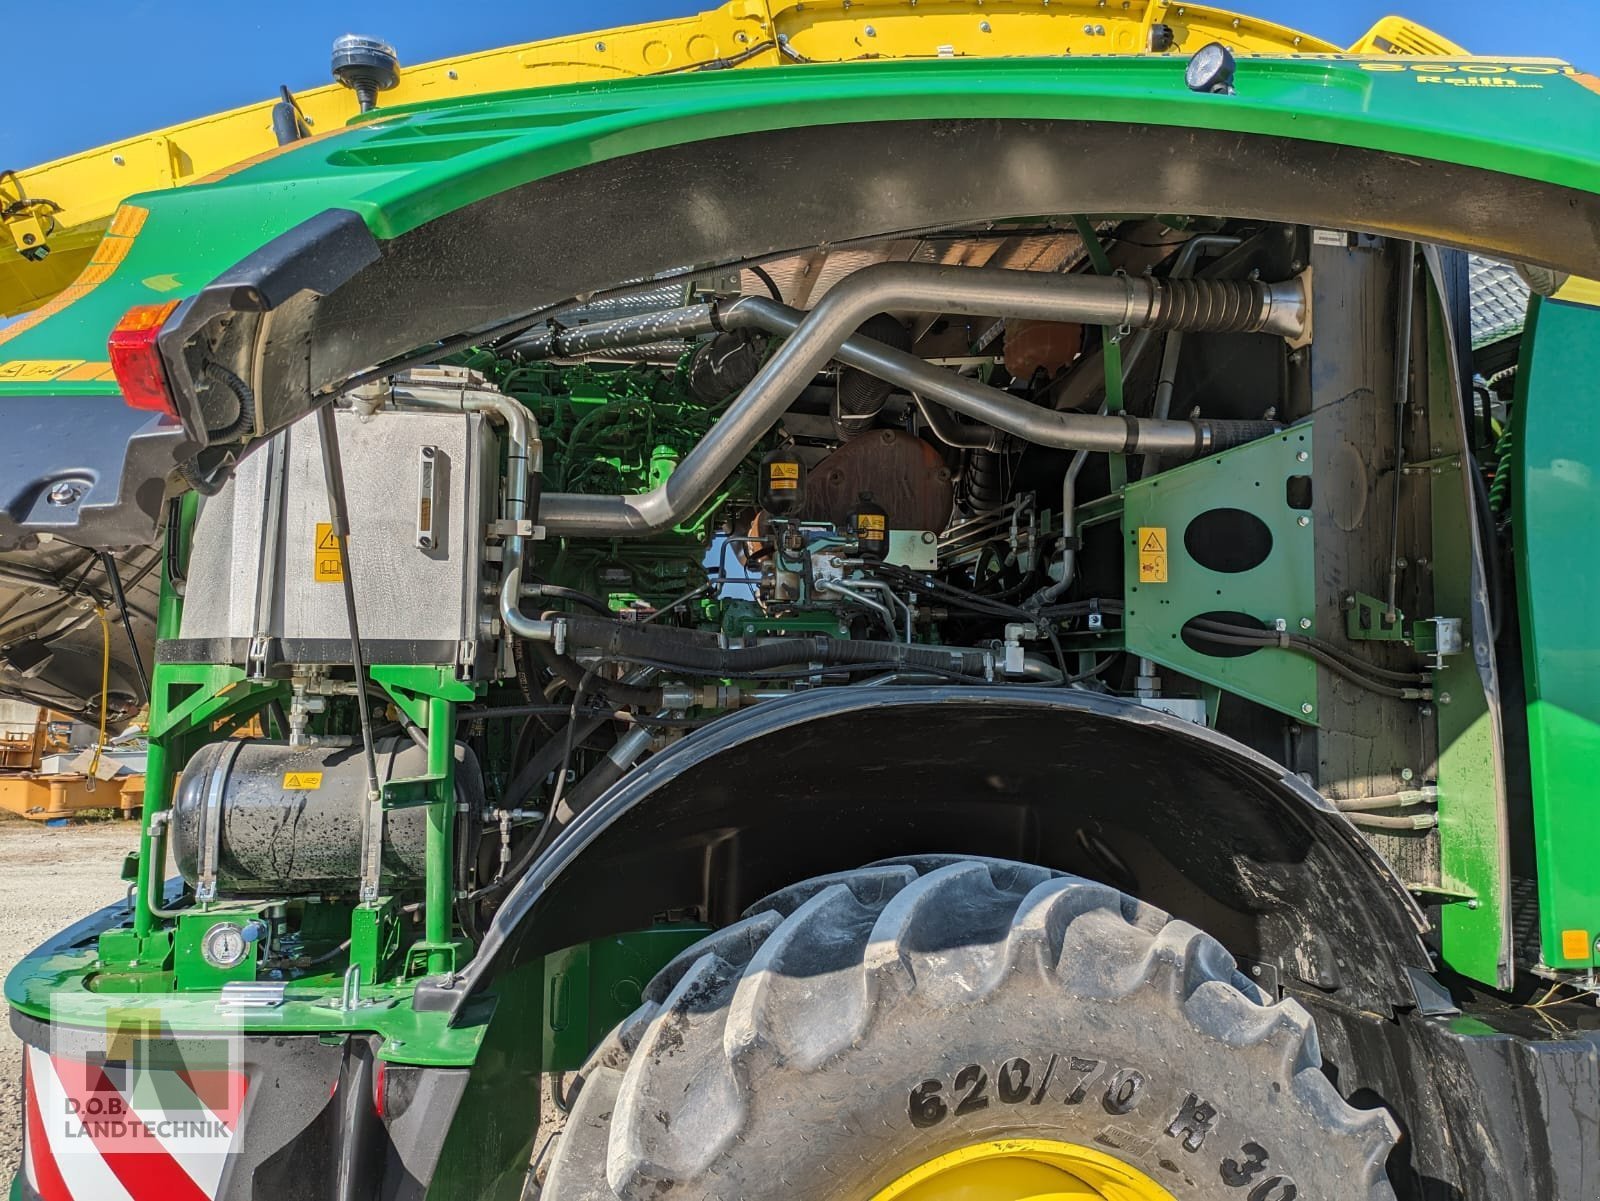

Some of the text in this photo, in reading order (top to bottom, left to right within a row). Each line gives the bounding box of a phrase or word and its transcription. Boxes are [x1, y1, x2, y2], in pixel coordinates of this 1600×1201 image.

[1417, 75, 1516, 85] Reith
[908, 1053, 1146, 1128] 620/70
[1219, 1141, 1298, 1201] 30
